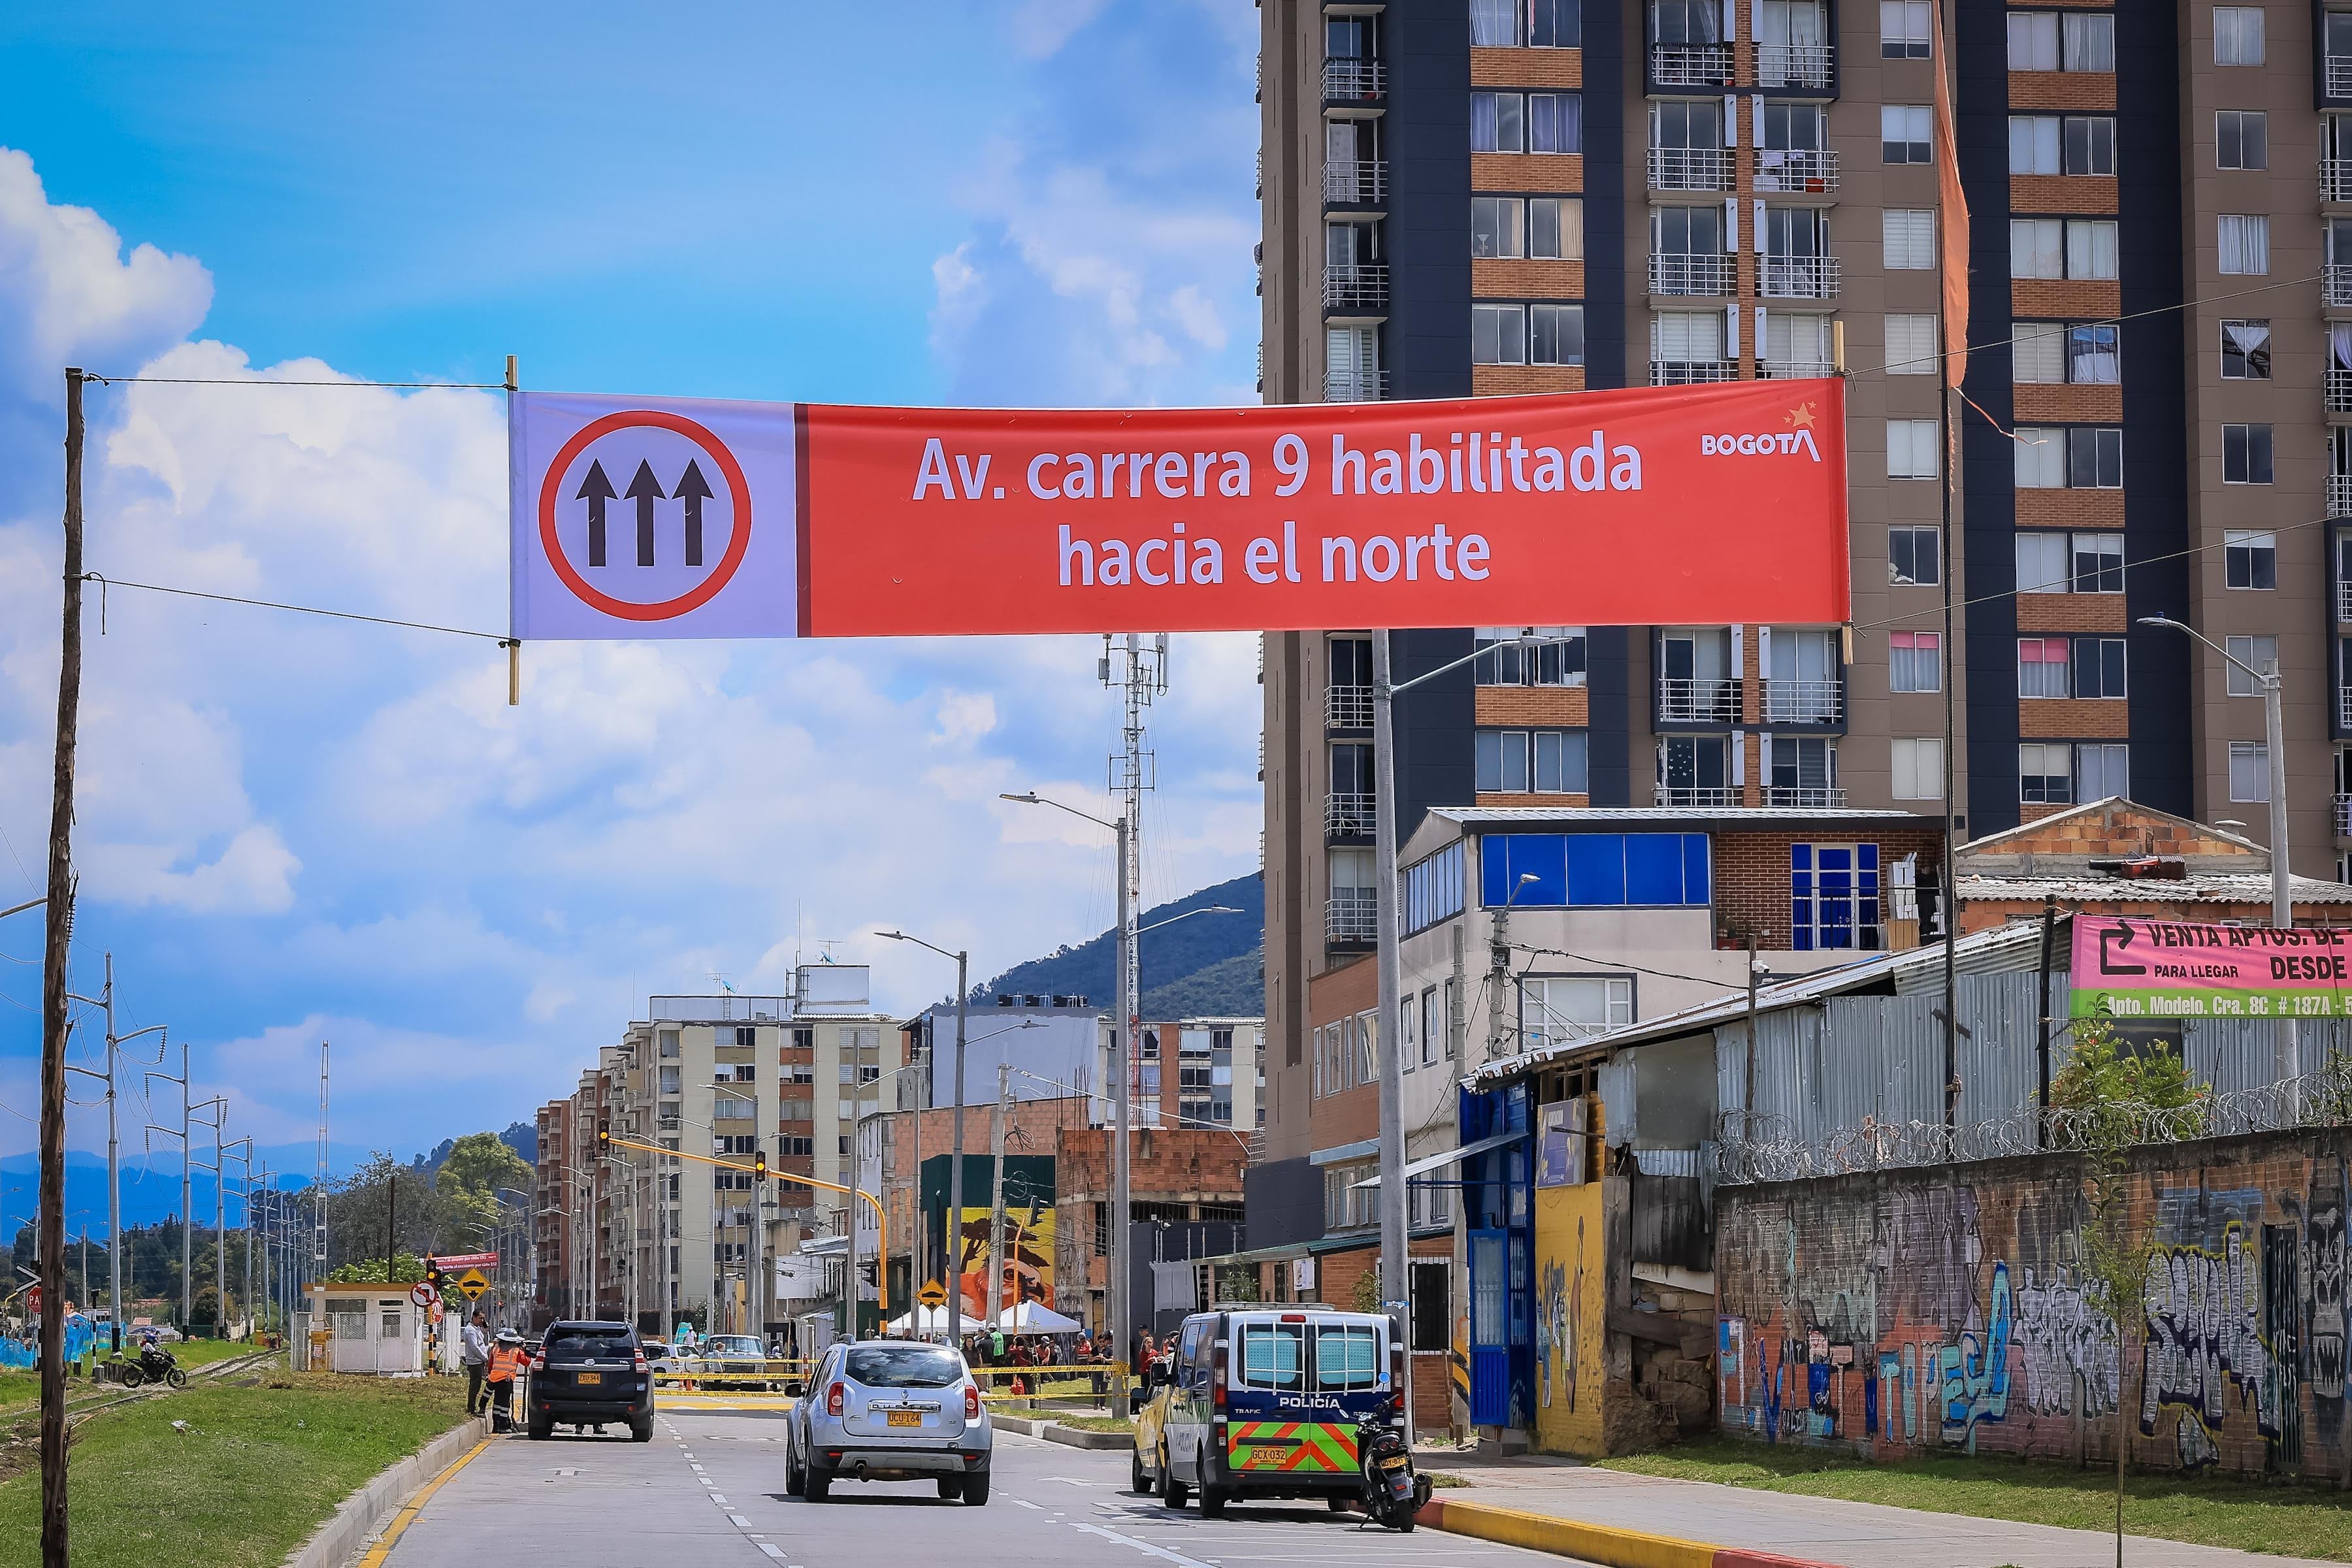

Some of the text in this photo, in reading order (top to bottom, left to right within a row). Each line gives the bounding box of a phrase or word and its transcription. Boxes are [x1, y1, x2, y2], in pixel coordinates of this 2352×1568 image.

[912, 429, 1642, 500] Av. carrera 9 habilitada
[1058, 521, 1491, 586] hacia el norte
[2146, 924, 2222, 947] VENTA
[2155, 965, 2239, 979] PARA LLEGAR
[2270, 955, 2347, 980] DESDE
[2108, 996, 2146, 1018] Apto.
[2149, 996, 2208, 1015] Modelo.
[2212, 996, 2245, 1015] Cra.
[2249, 996, 2268, 1015] 8C
[2278, 996, 2287, 1015] #
[2293, 996, 2331, 1015] 187A
[1279, 1396, 1340, 1409] POLICÍA
